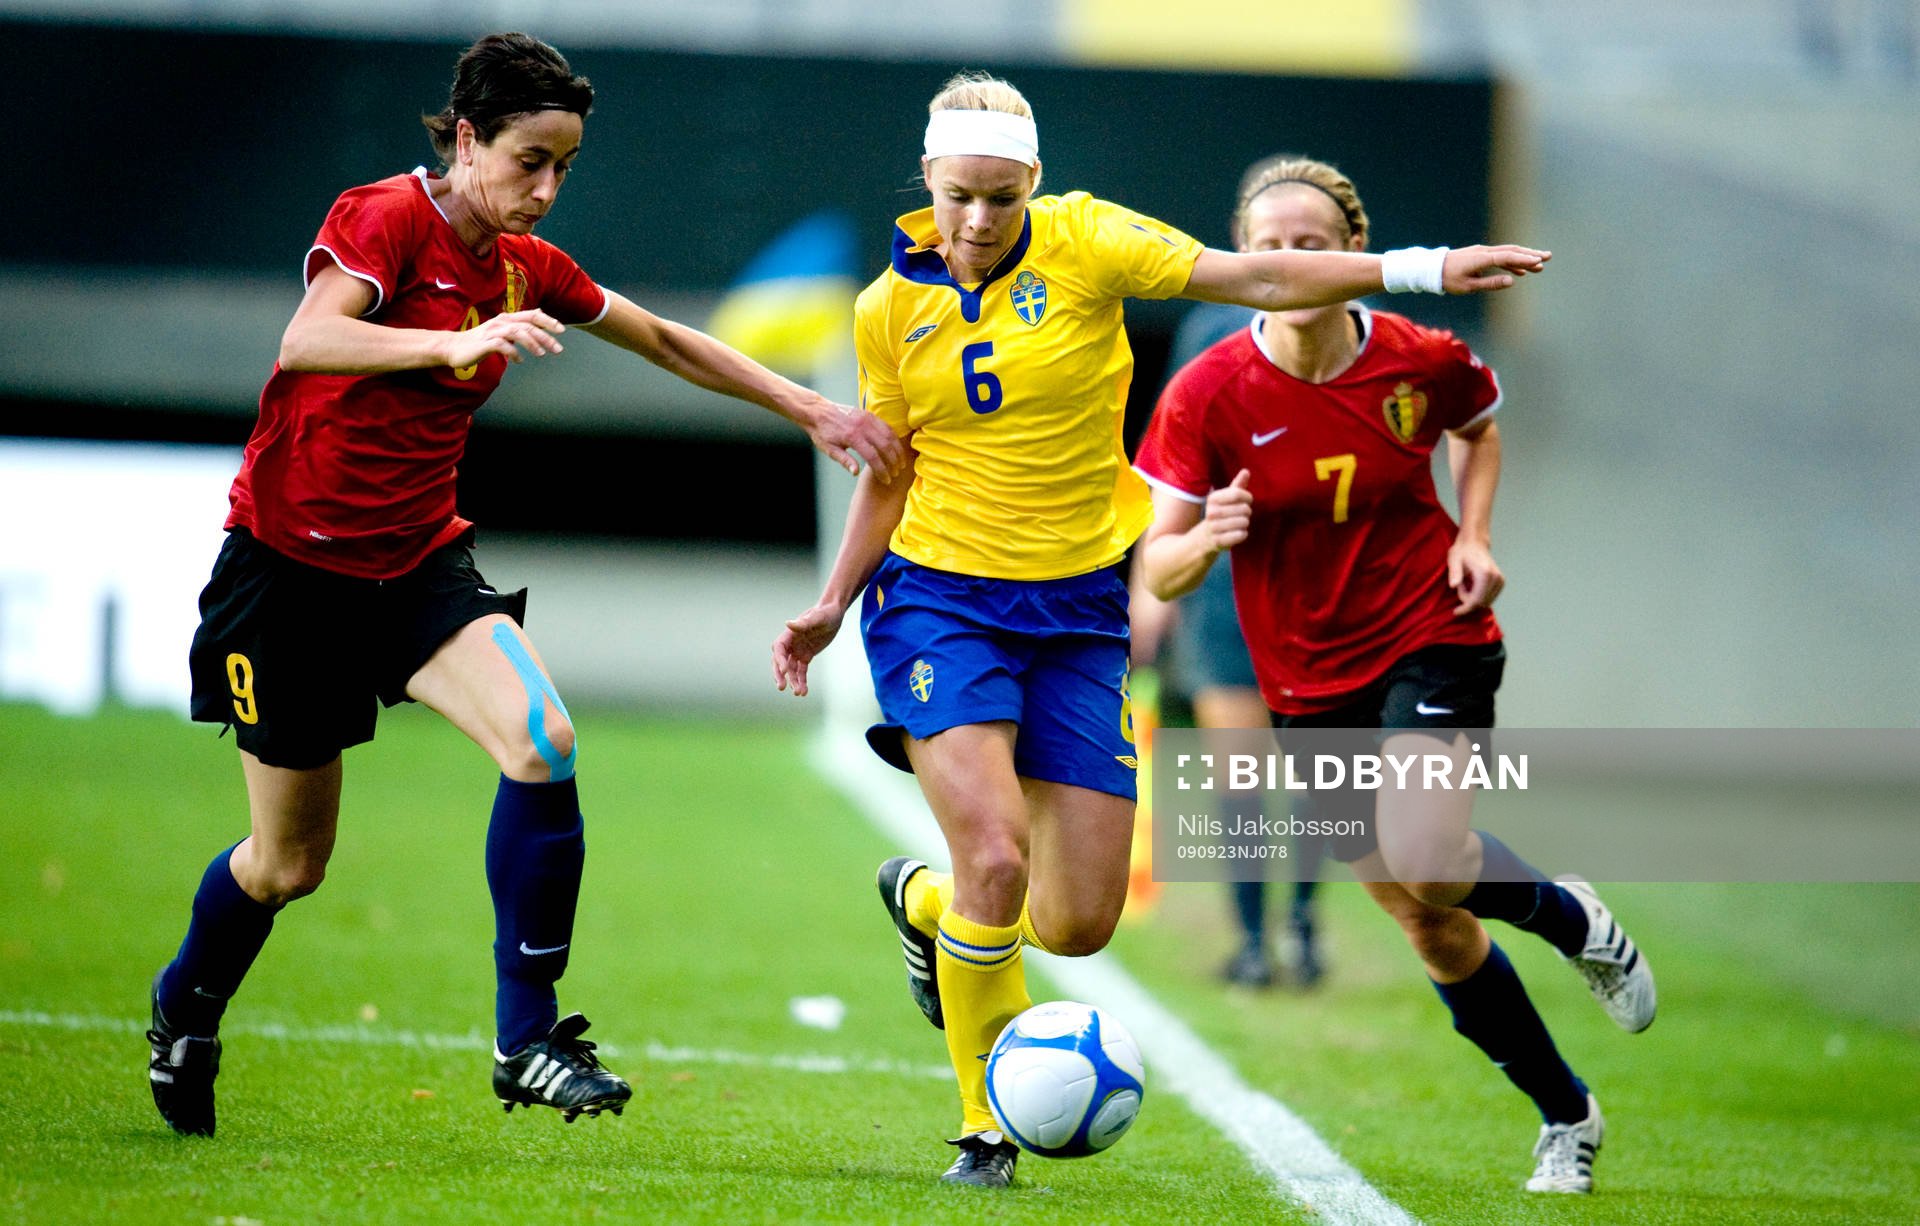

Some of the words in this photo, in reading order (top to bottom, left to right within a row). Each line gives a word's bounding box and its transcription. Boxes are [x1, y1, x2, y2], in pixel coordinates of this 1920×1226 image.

[963, 341, 1001, 414] 6
[1314, 453, 1358, 524] 7
[226, 652, 258, 724] 9
